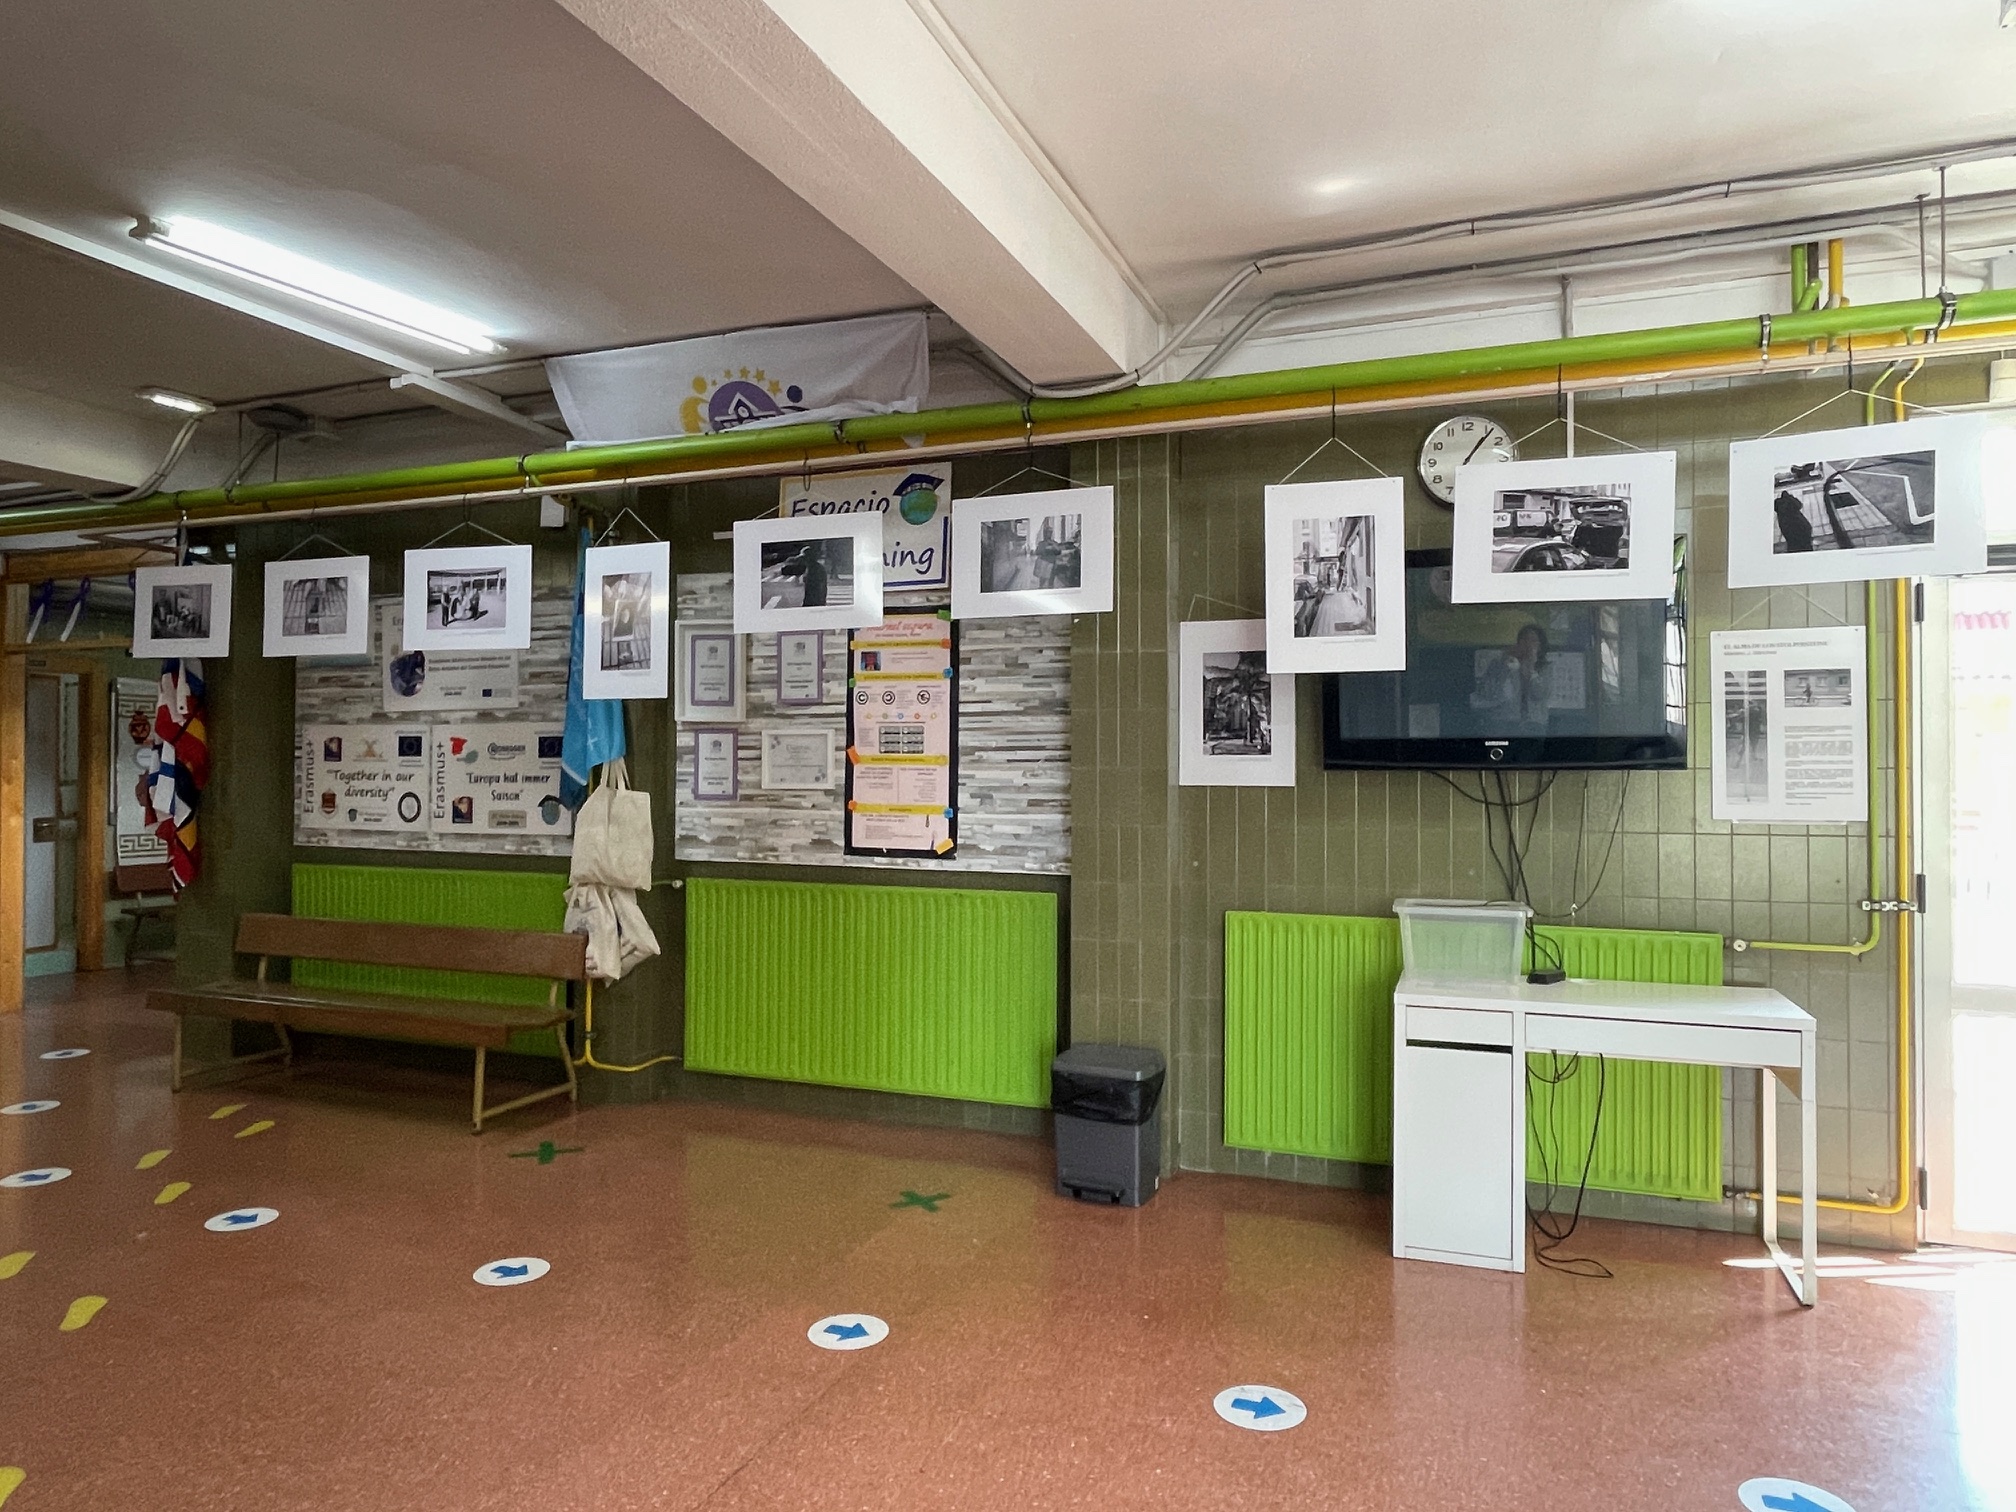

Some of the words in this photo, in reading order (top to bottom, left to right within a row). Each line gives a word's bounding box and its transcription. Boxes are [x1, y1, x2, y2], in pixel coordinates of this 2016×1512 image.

[1462, 422, 1474, 431] 12
[1447, 428, 1455, 437] 11
[1494, 437, 1503, 446] 2
[1433, 442, 1443, 451] 10
[1427, 459, 1437, 468] 9
[1432, 475, 1443, 484] 8
[1446, 487, 1454, 495] 7
[302, 739, 315, 814] Erasmus+
[381, 769, 392, 782] in
[396, 772, 415, 782] our
[433, 741, 446, 819] Erasmus+
